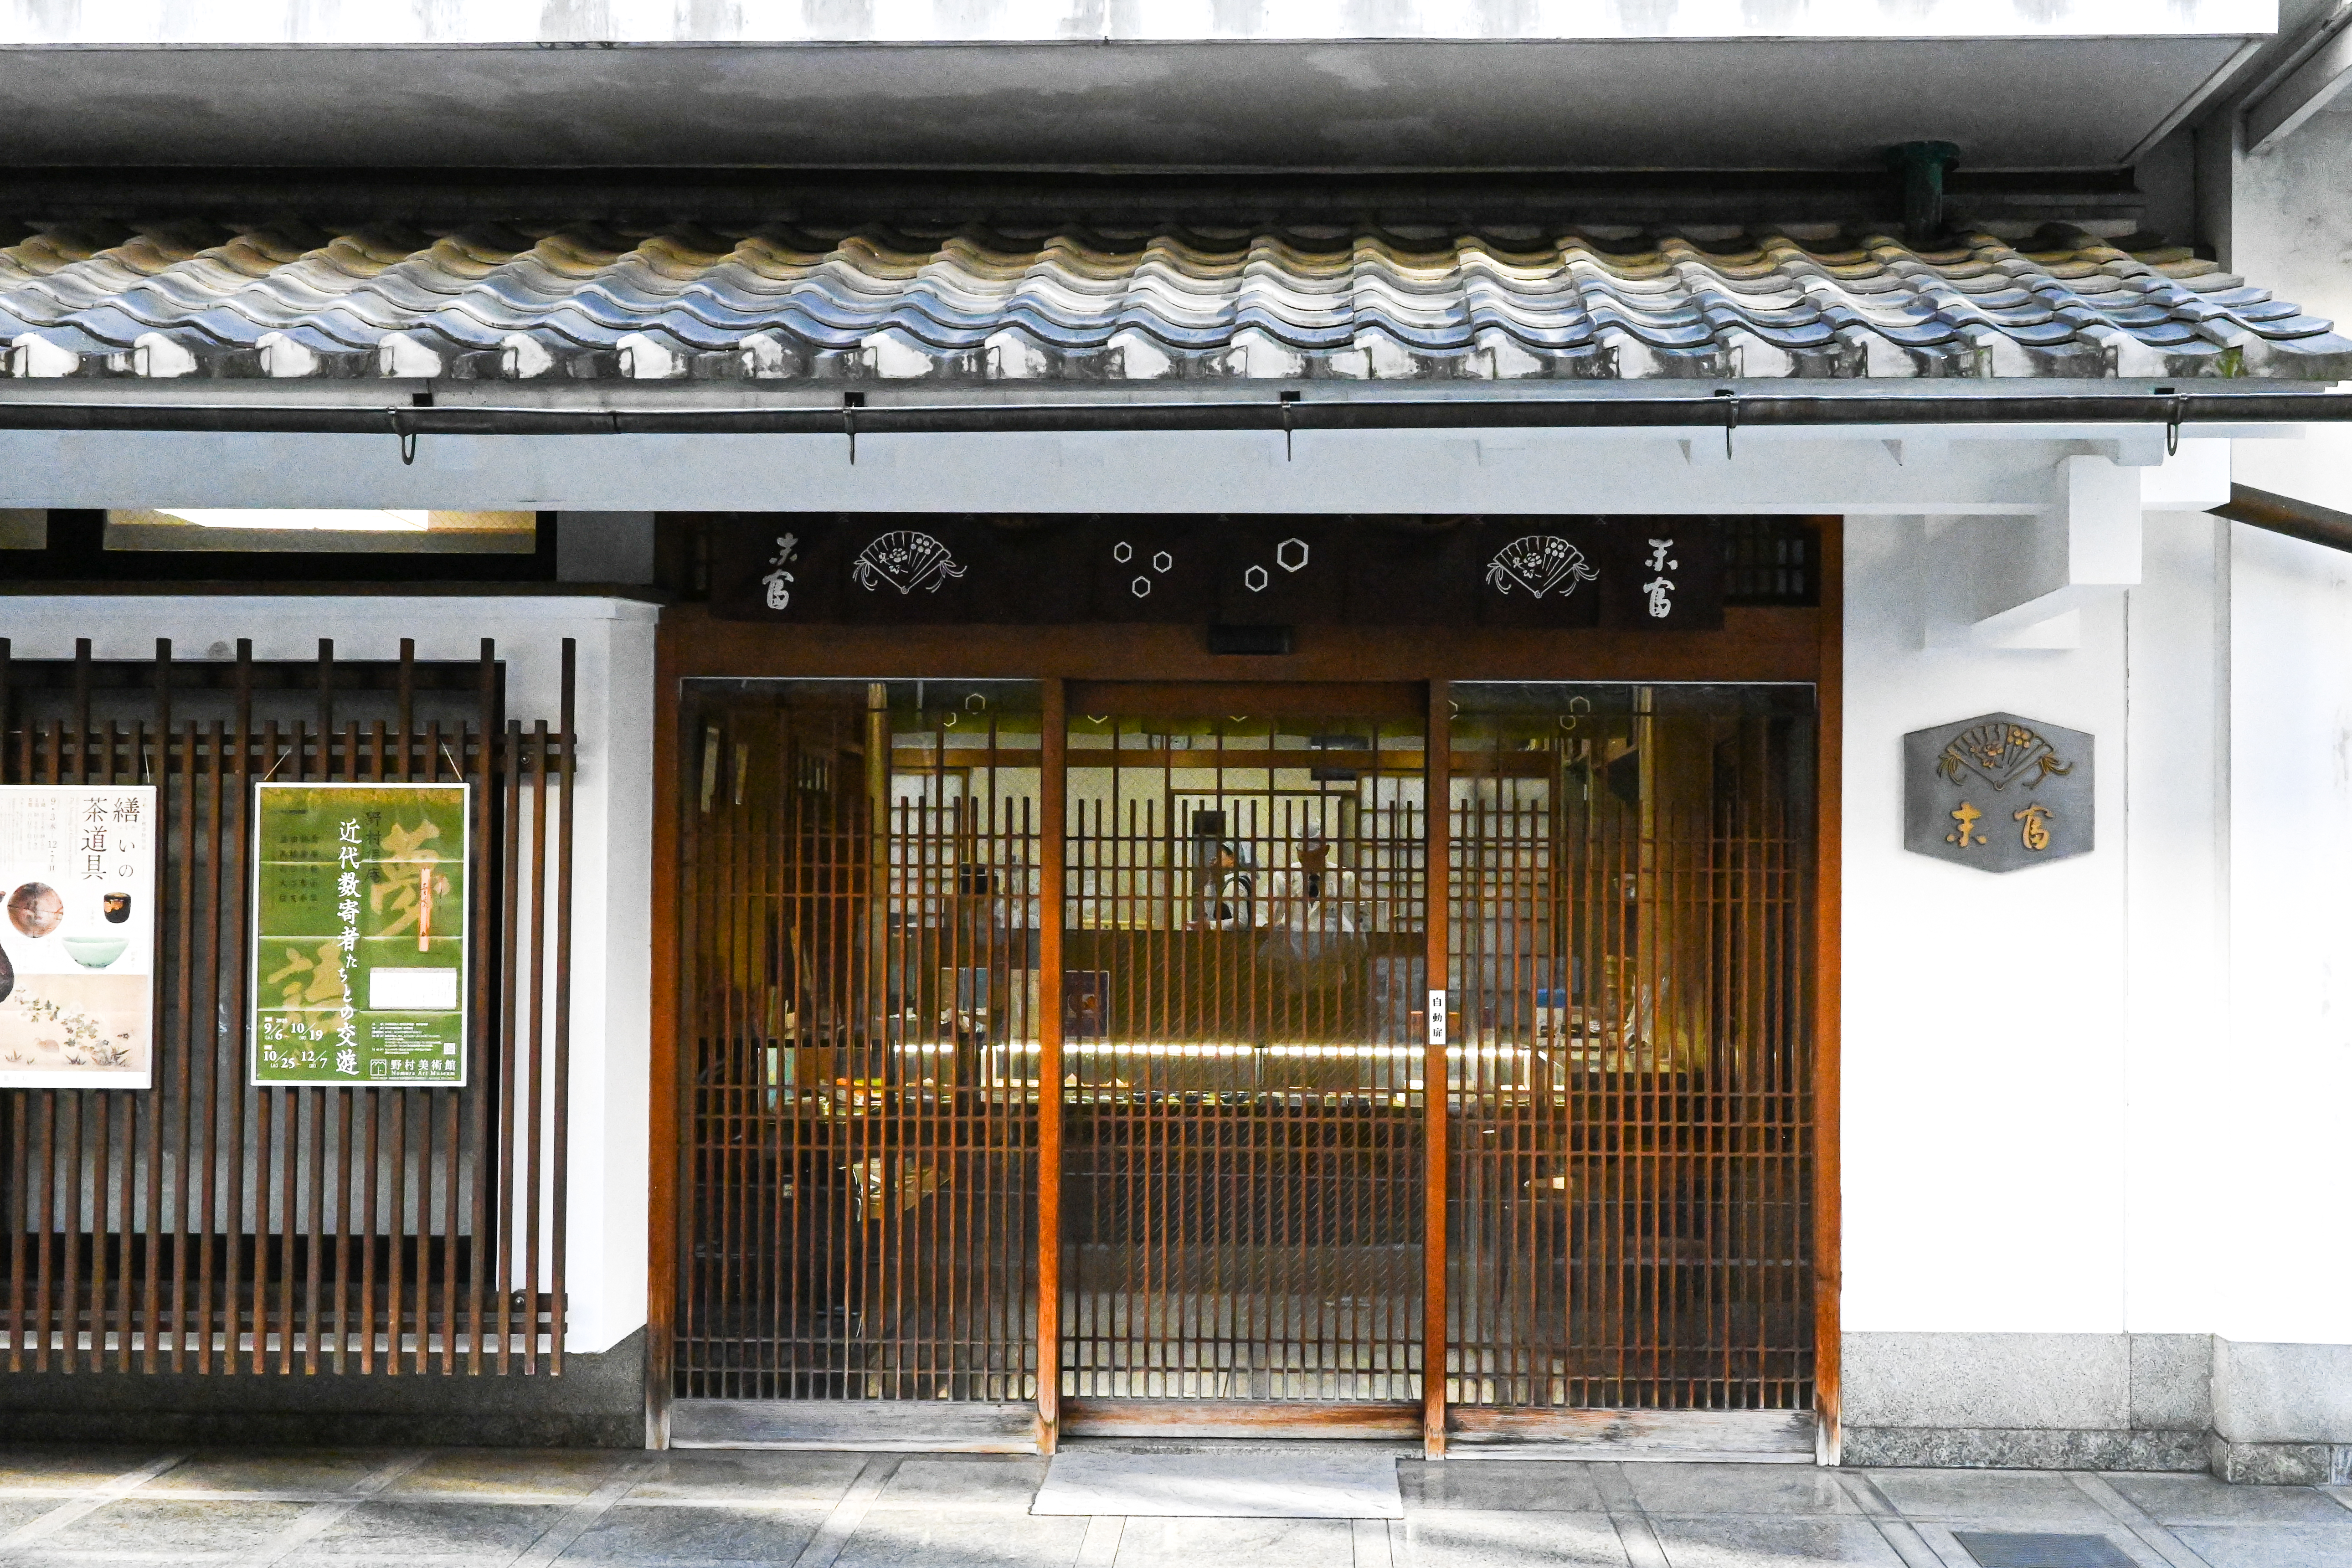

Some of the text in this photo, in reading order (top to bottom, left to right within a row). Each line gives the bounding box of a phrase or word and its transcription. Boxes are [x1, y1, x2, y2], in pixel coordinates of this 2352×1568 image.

[81, 797, 108, 880] 茶道具
[113, 797, 140, 877] 繕いの
[335, 818, 362, 1076] 近代数寄者たちとの交遊
[1433, 997, 1442, 1037] 自動扉
[391, 1059, 456, 1070] 野村美術館
